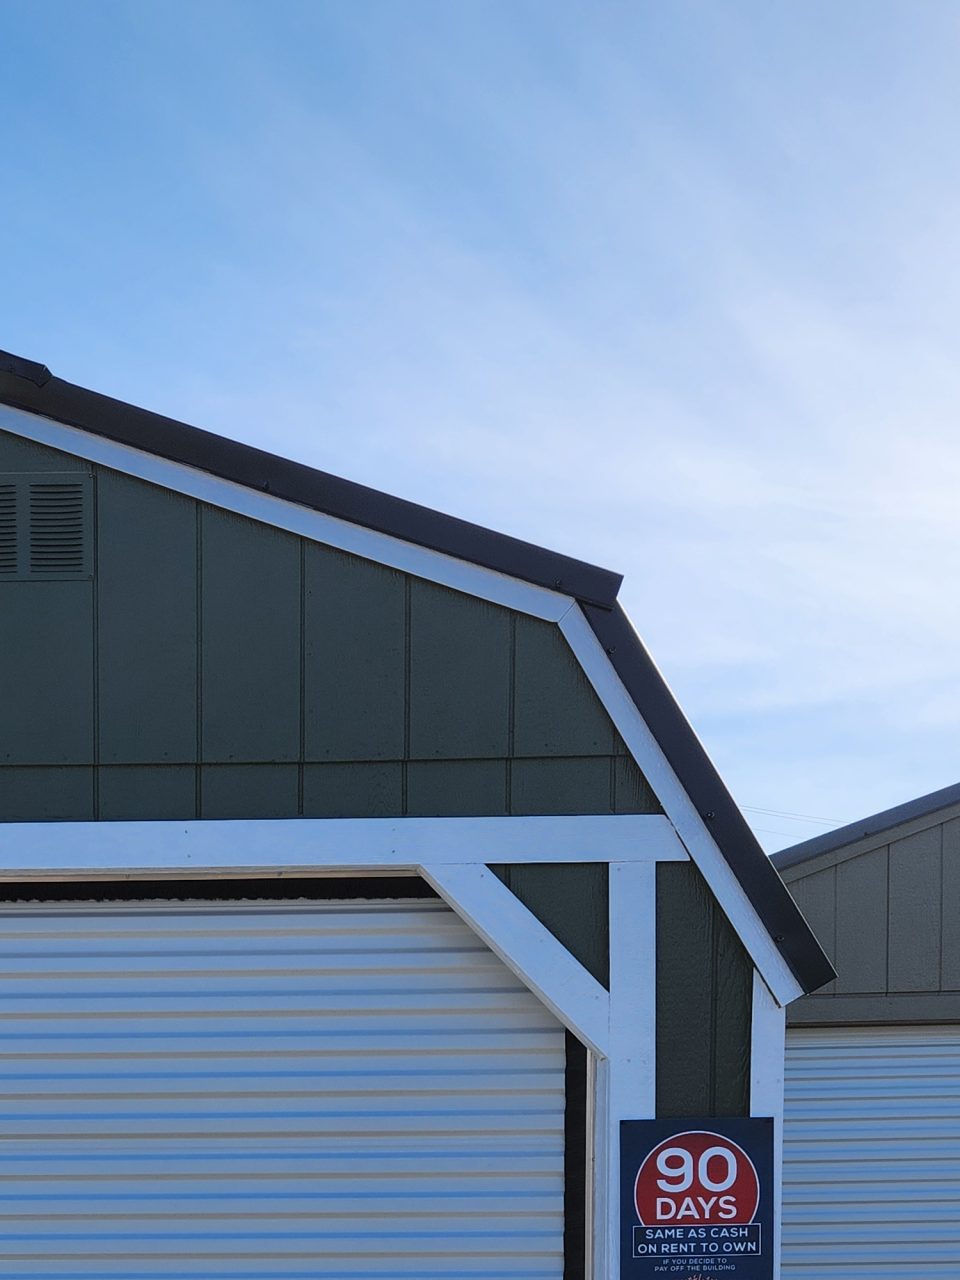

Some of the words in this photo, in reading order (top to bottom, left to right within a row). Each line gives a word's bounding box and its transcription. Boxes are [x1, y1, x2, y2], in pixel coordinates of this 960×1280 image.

[656, 1146, 738, 1193] 90
[656, 1195, 737, 1220] DAYS
[645, 1228, 684, 1239] SAME
[687, 1228, 707, 1239] AS
[710, 1227, 749, 1238] CASH
[637, 1243, 657, 1254] ON
[661, 1242, 697, 1253] RENT
[700, 1242, 719, 1253] TO
[722, 1241, 756, 1252] OWN
